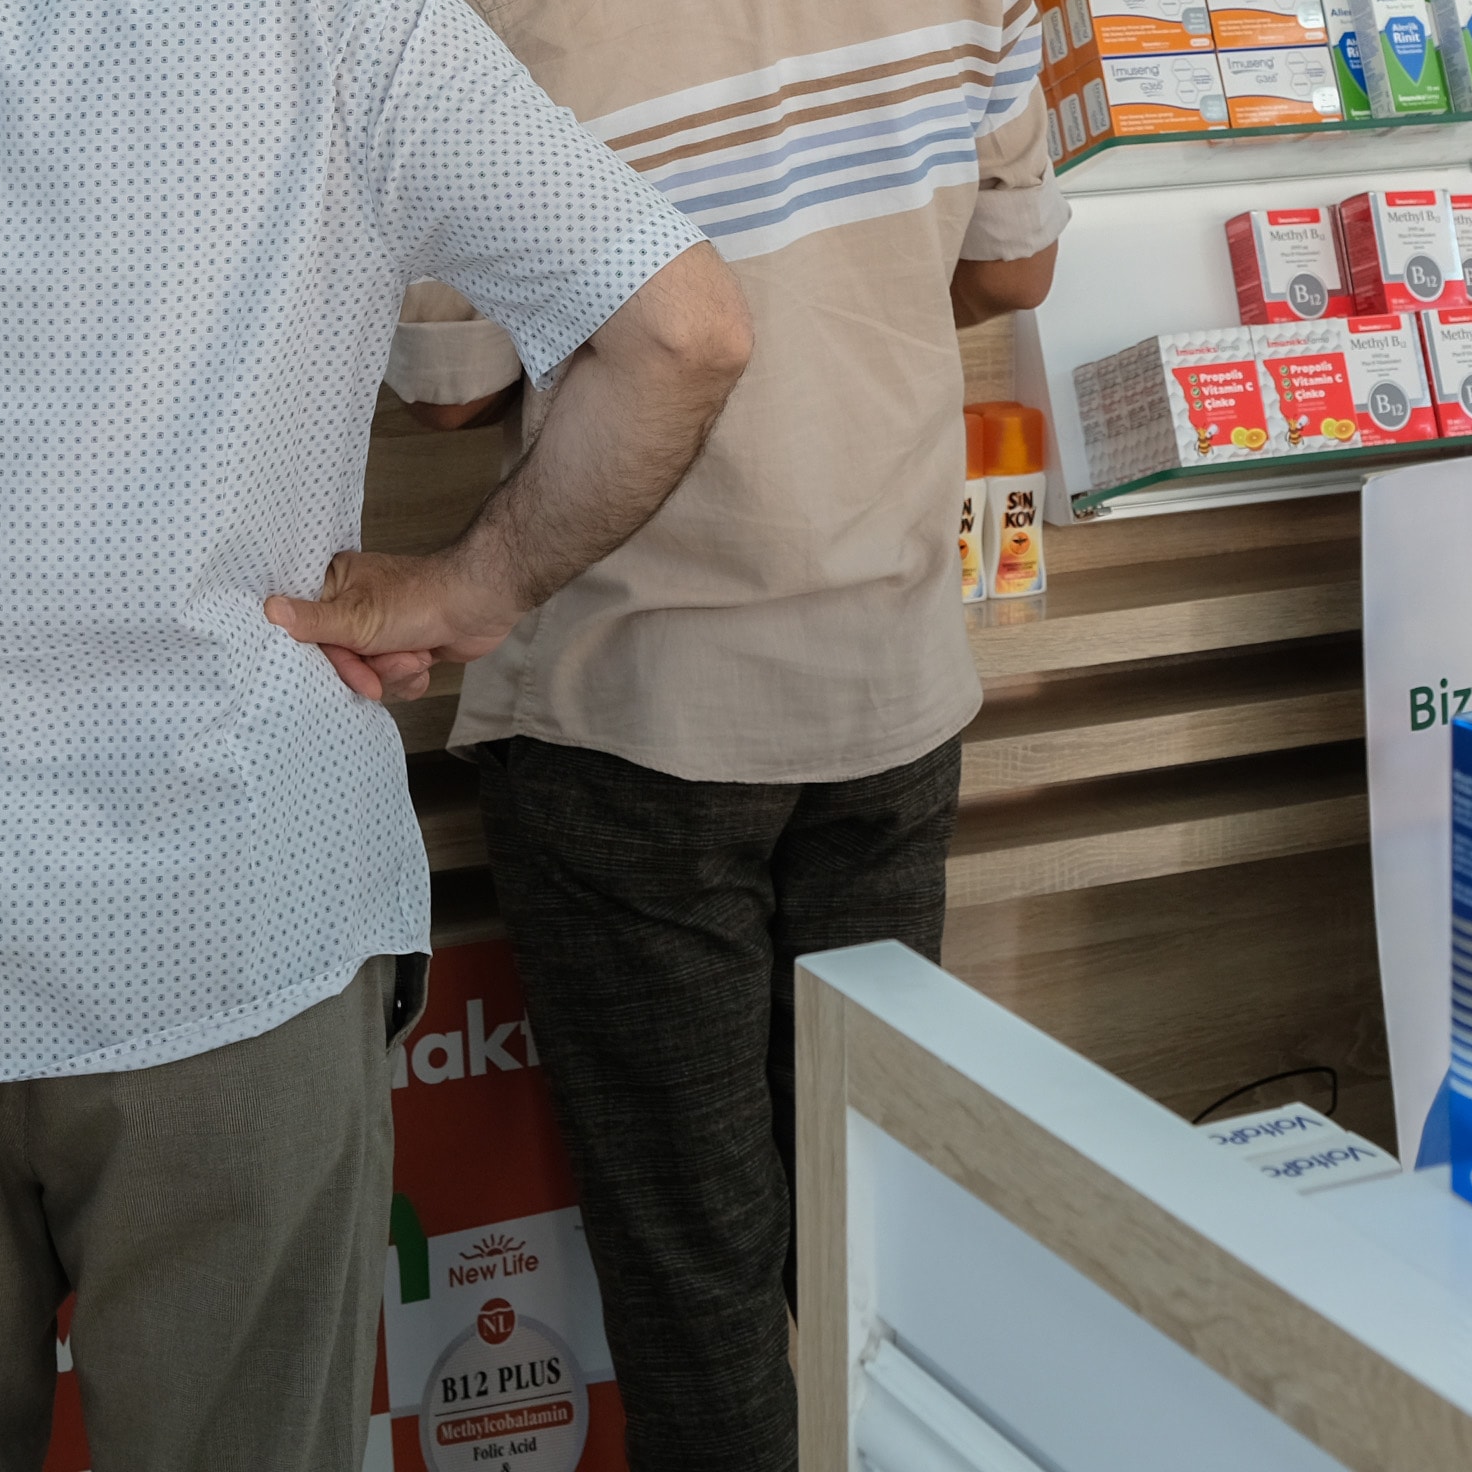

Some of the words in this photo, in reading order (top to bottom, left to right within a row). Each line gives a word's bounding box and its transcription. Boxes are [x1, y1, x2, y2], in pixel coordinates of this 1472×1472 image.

[1393, 32, 1420, 44] Rinit
[1111, 63, 1160, 77] Imuseng
[1388, 211, 1424, 224] Methyl
[1269, 230, 1309, 242] Methyl
[1411, 265, 1438, 288] B12
[1294, 284, 1322, 306] B12
[1350, 337, 1389, 351] Methyl
[1199, 370, 1243, 383] Propolis
[1202, 383, 1244, 396] Vitamin
[1245, 382, 1253, 391] C
[1204, 398, 1236, 411] Çinko
[1376, 394, 1404, 416] B12
[1004, 510, 1036, 529] KOV
[448, 1260, 499, 1288] New
[502, 1251, 539, 1279] Life
[478, 1313, 514, 1336] NL
[441, 1372, 489, 1406] B12
[497, 1356, 562, 1396] PLUS
[440, 1403, 568, 1443] Methylcobalamin
[473, 1441, 505, 1462] Folic
[507, 1436, 537, 1455] Acid
